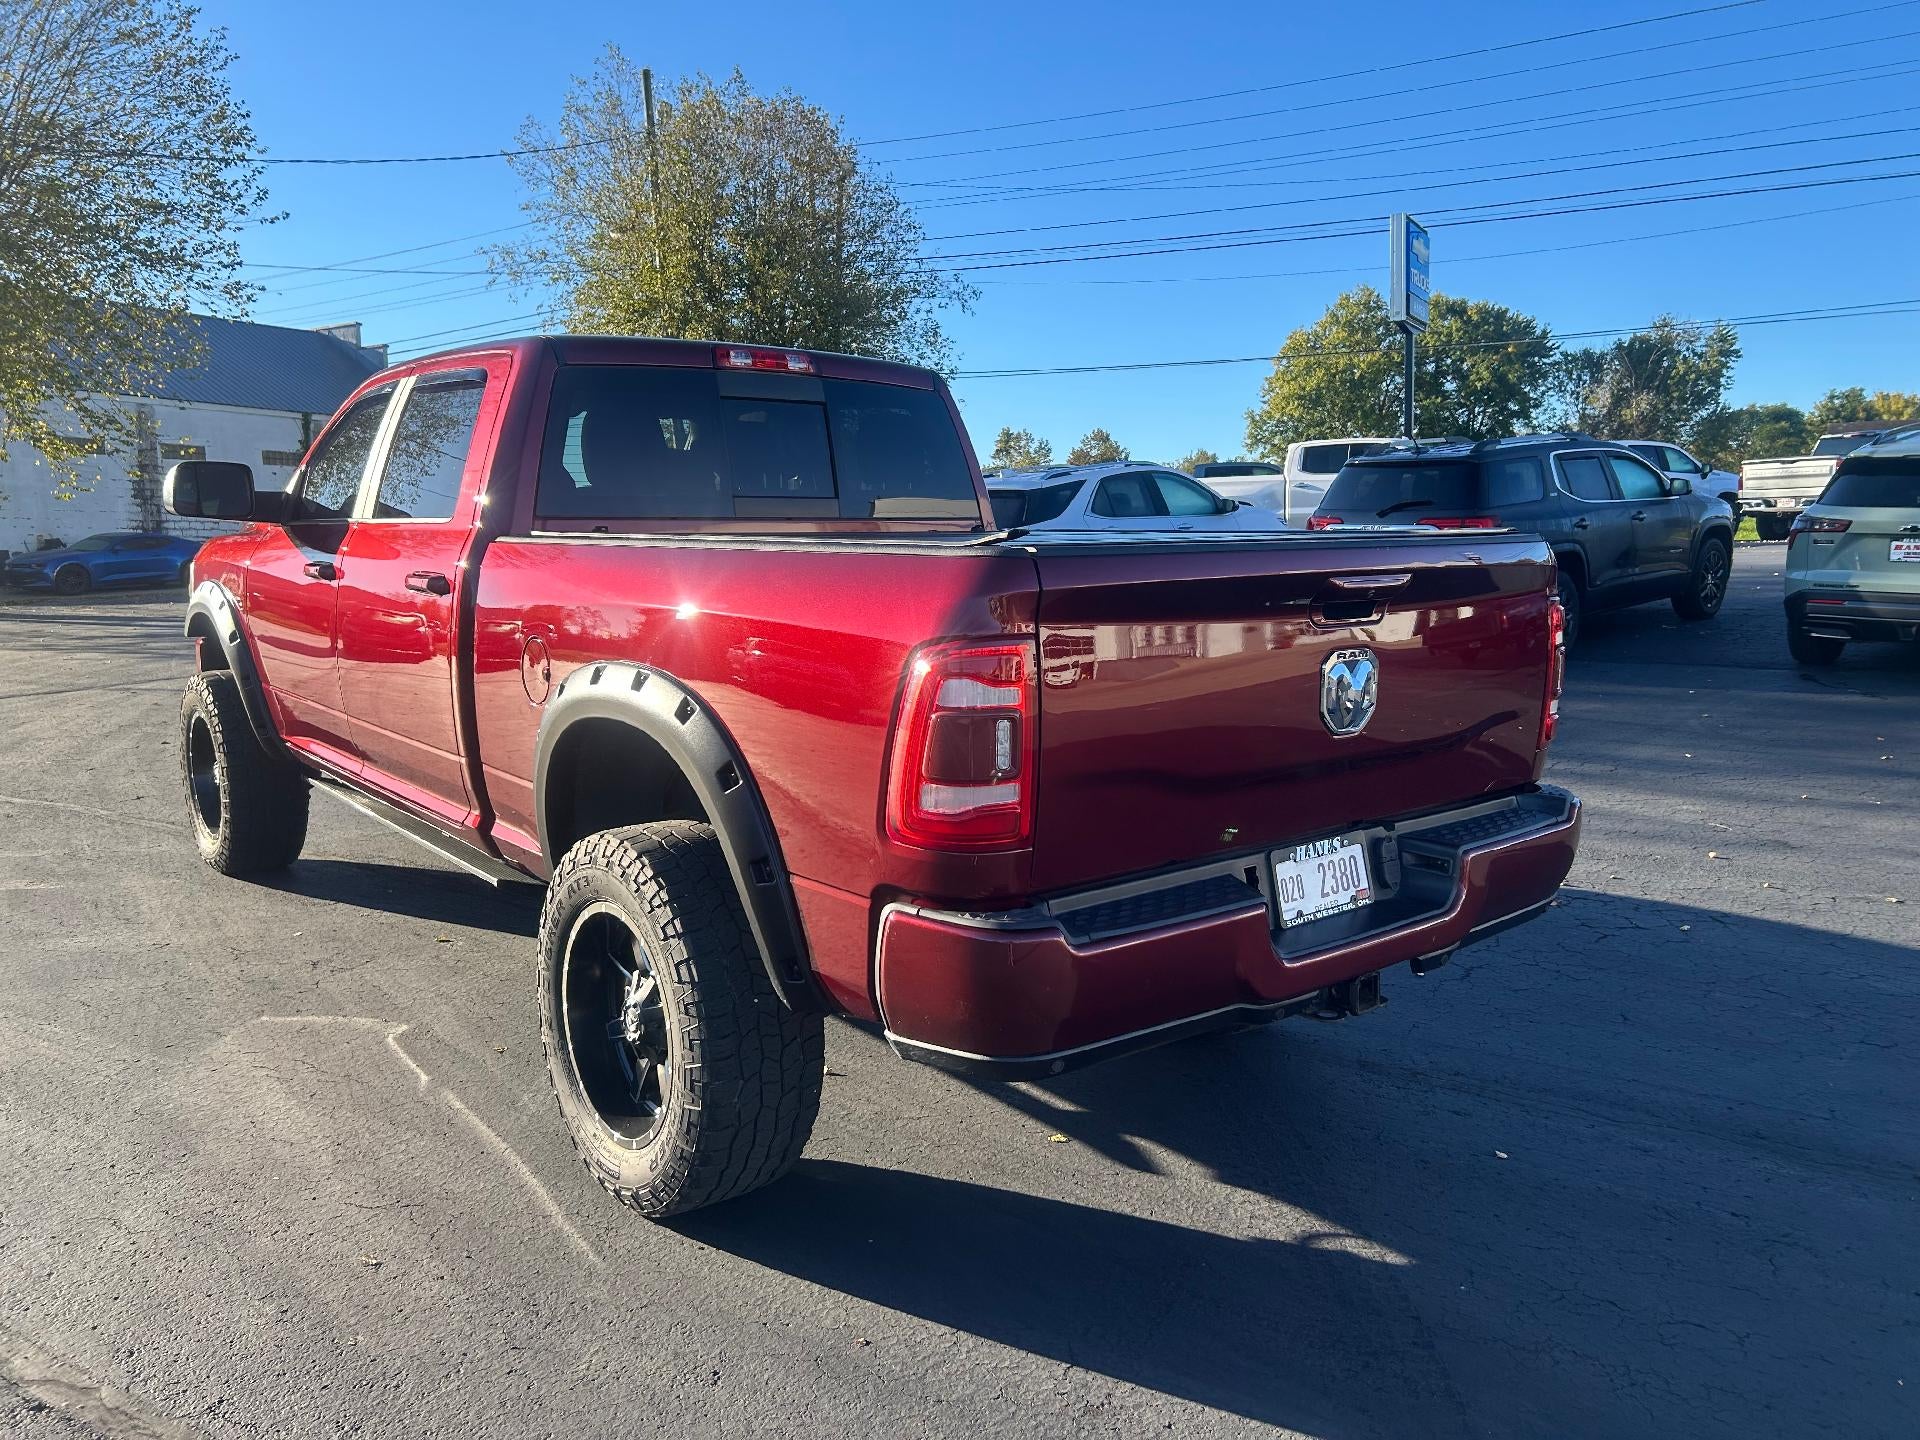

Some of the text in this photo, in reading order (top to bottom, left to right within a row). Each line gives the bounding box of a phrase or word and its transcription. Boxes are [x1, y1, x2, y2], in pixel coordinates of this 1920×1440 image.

[1337, 651, 1368, 660] RAM
[1280, 855, 1361, 903] 020 2380
[1287, 914, 1314, 927] SOUTH
